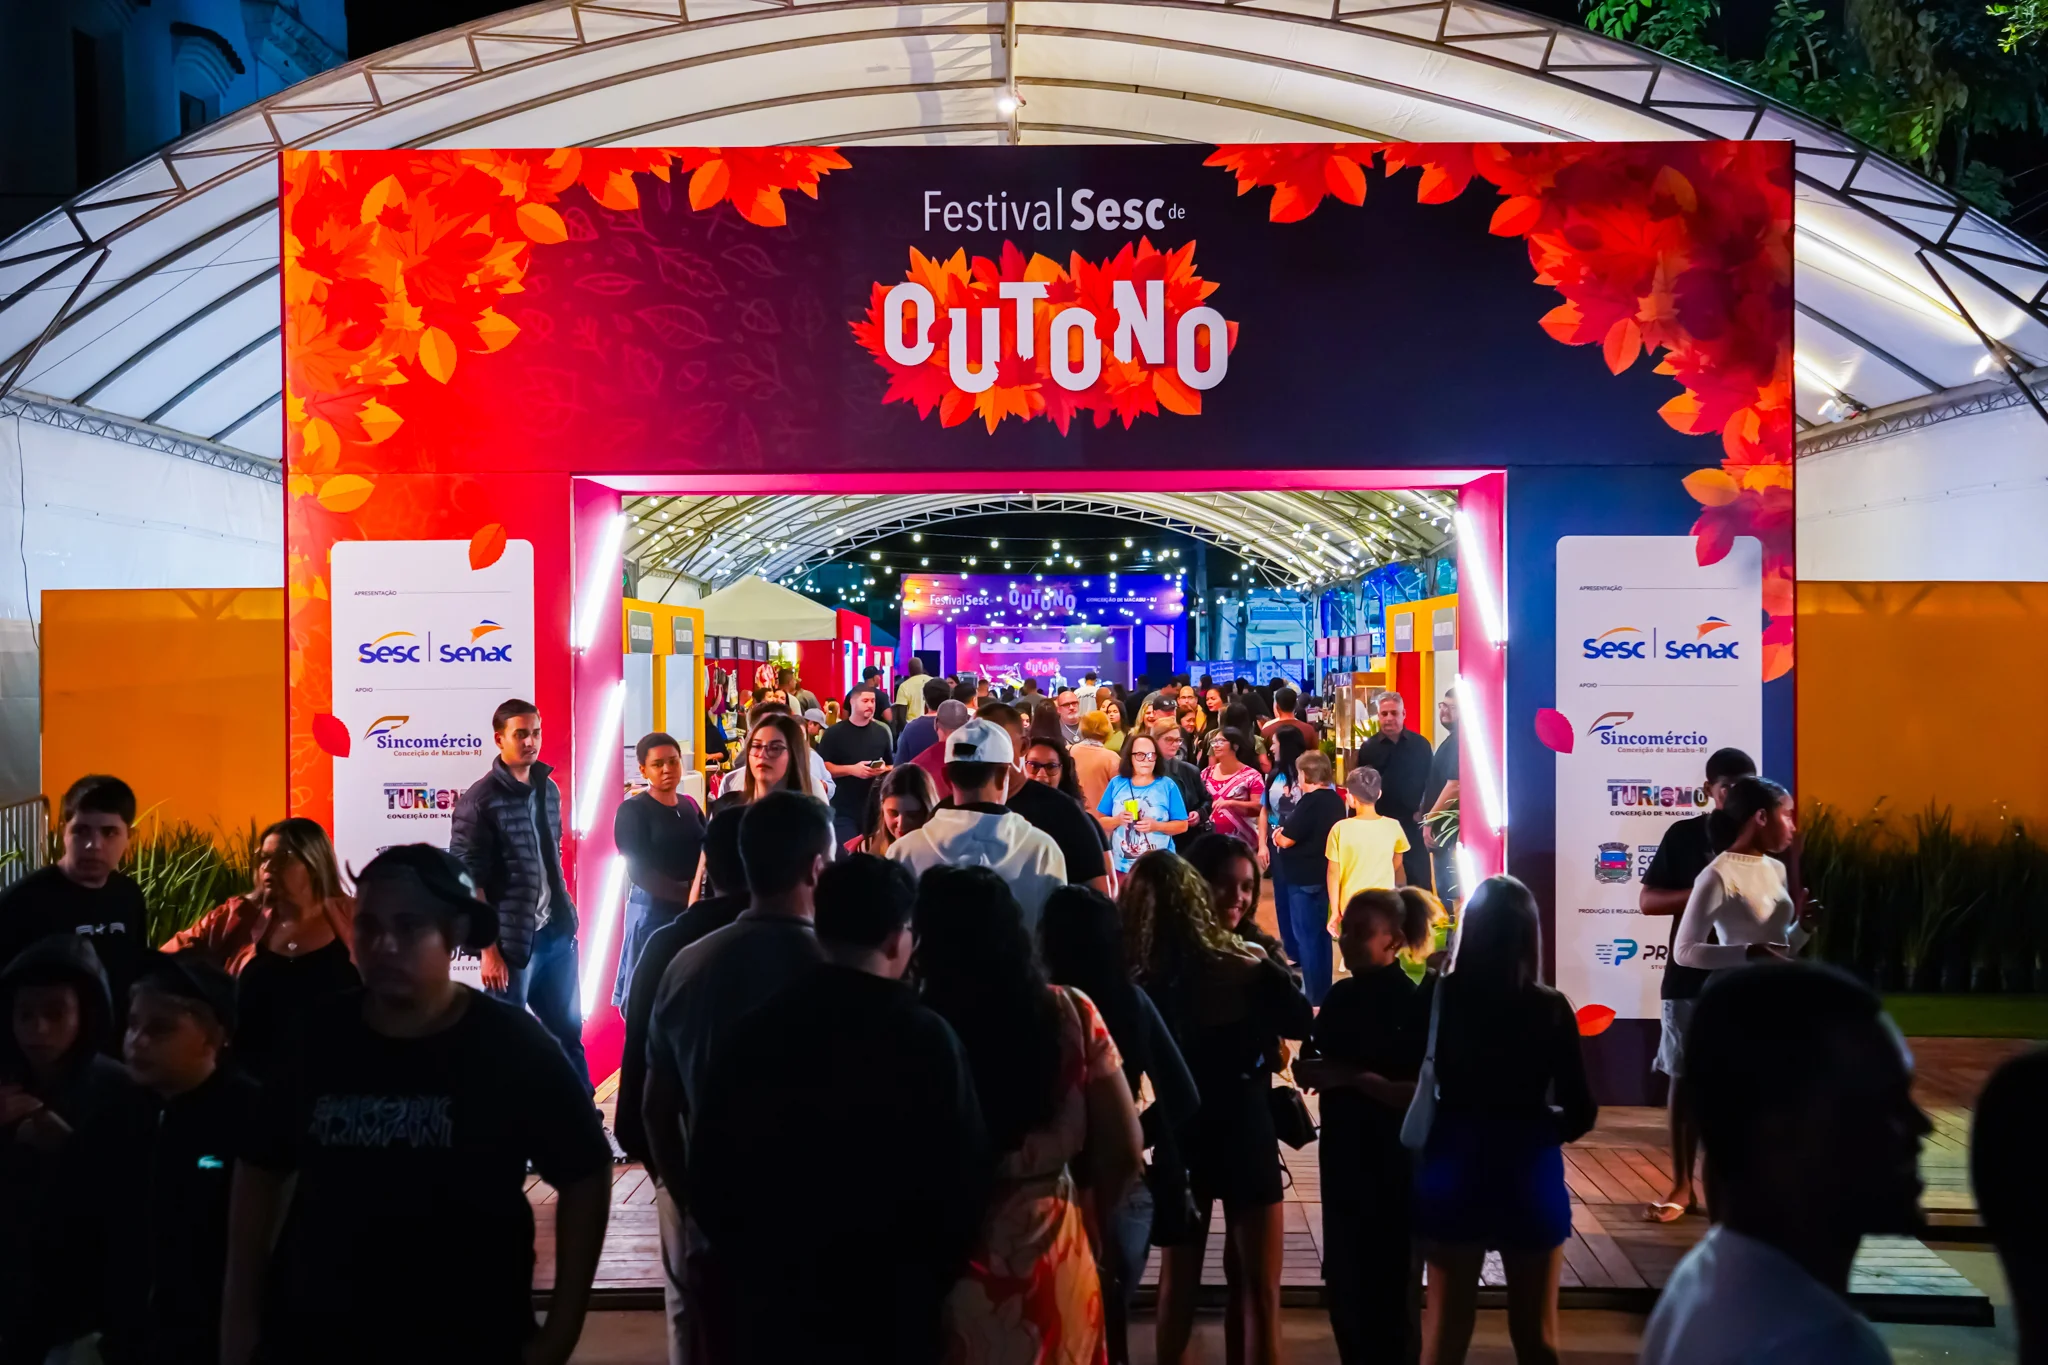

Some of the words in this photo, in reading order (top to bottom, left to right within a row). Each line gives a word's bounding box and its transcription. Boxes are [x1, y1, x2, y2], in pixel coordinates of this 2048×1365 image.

[1168, 203, 1186, 220] de
[884, 280, 1228, 394] OUTONO
[1008, 589, 1076, 611] OUTONO
[358, 643, 420, 664] Sesc
[439, 644, 512, 663] Senac
[1583, 638, 1645, 660] Sesc
[1665, 640, 1739, 660] Senac
[377, 734, 482, 749] Sincomércio
[1601, 731, 1707, 745] Sincomércio
[393, 750, 429, 758] Conceição
[384, 788, 468, 810] TURISM
[1607, 785, 1709, 807] TURISMO
[1610, 809, 1652, 817] CONCEIÇÃO
